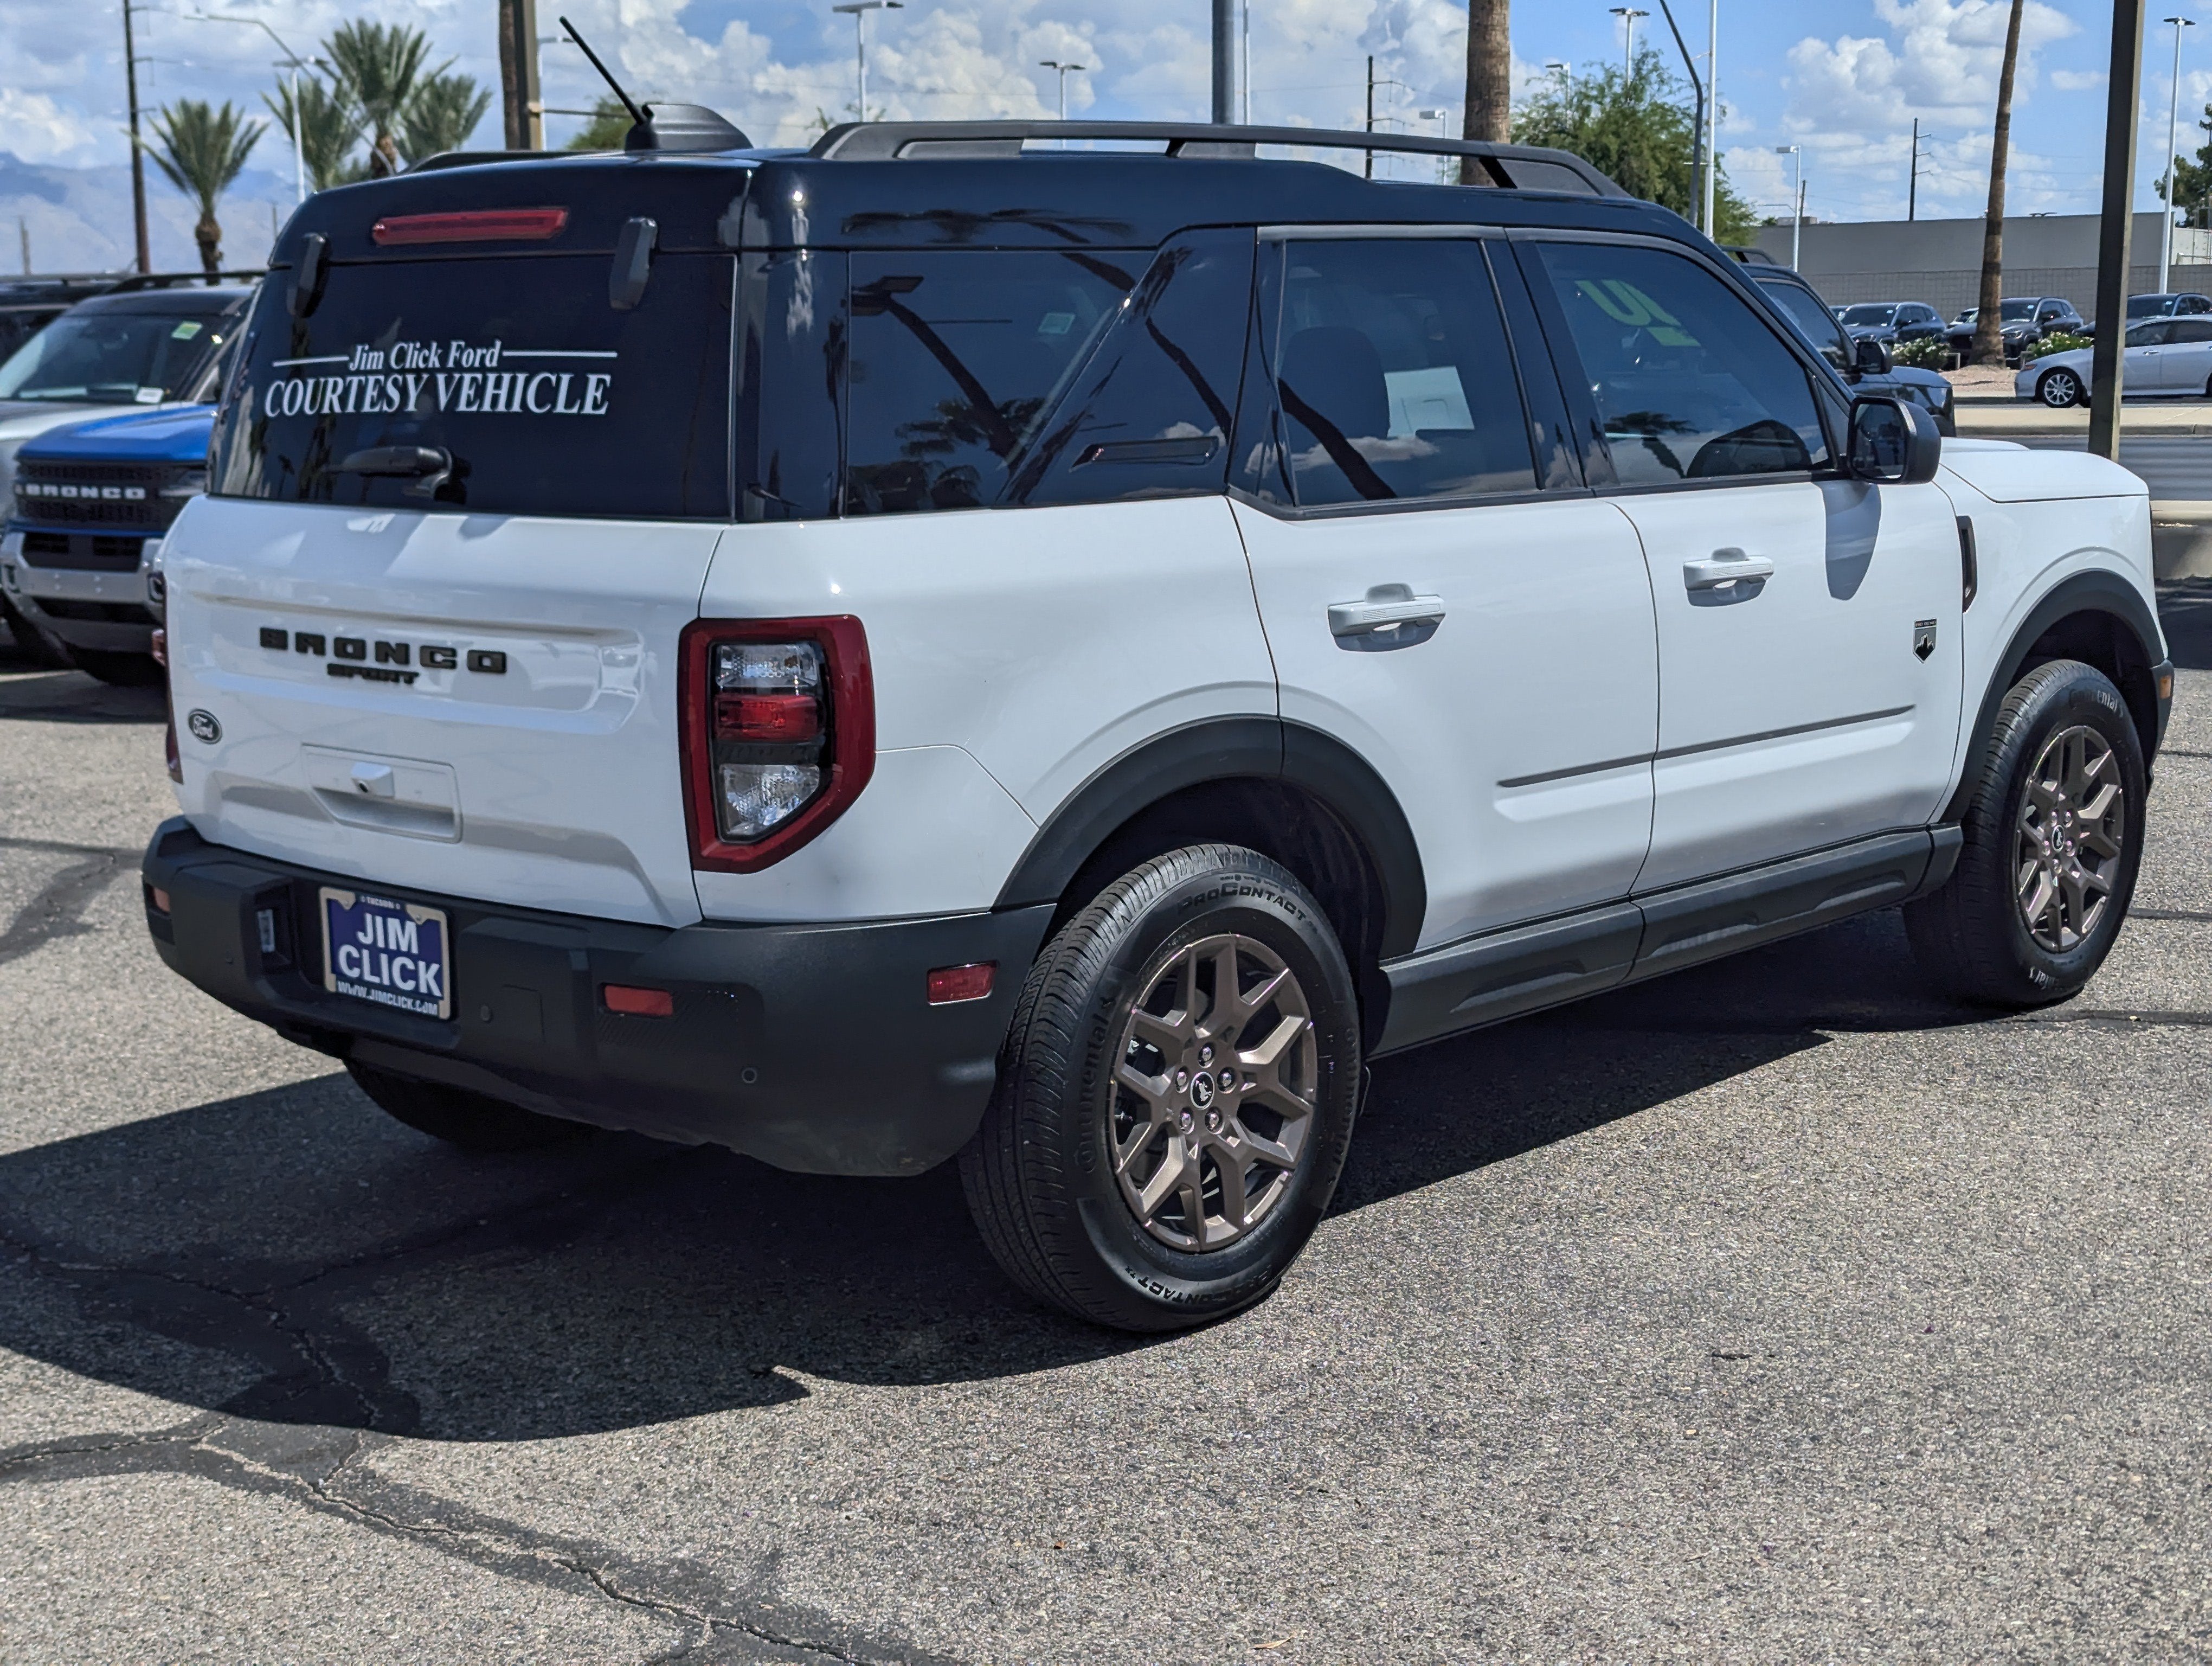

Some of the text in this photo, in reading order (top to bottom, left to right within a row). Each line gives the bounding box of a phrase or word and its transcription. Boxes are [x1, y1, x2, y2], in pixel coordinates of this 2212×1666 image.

[349, 339, 501, 371] Jim Click Ford
[265, 373, 612, 416] COURTESY VEHICLE
[26, 483, 145, 499] BRONCO
[259, 627, 507, 674] BRONCO
[326, 663, 420, 684] SPORT
[357, 913, 419, 954] JIM
[338, 945, 441, 997] CLICK
